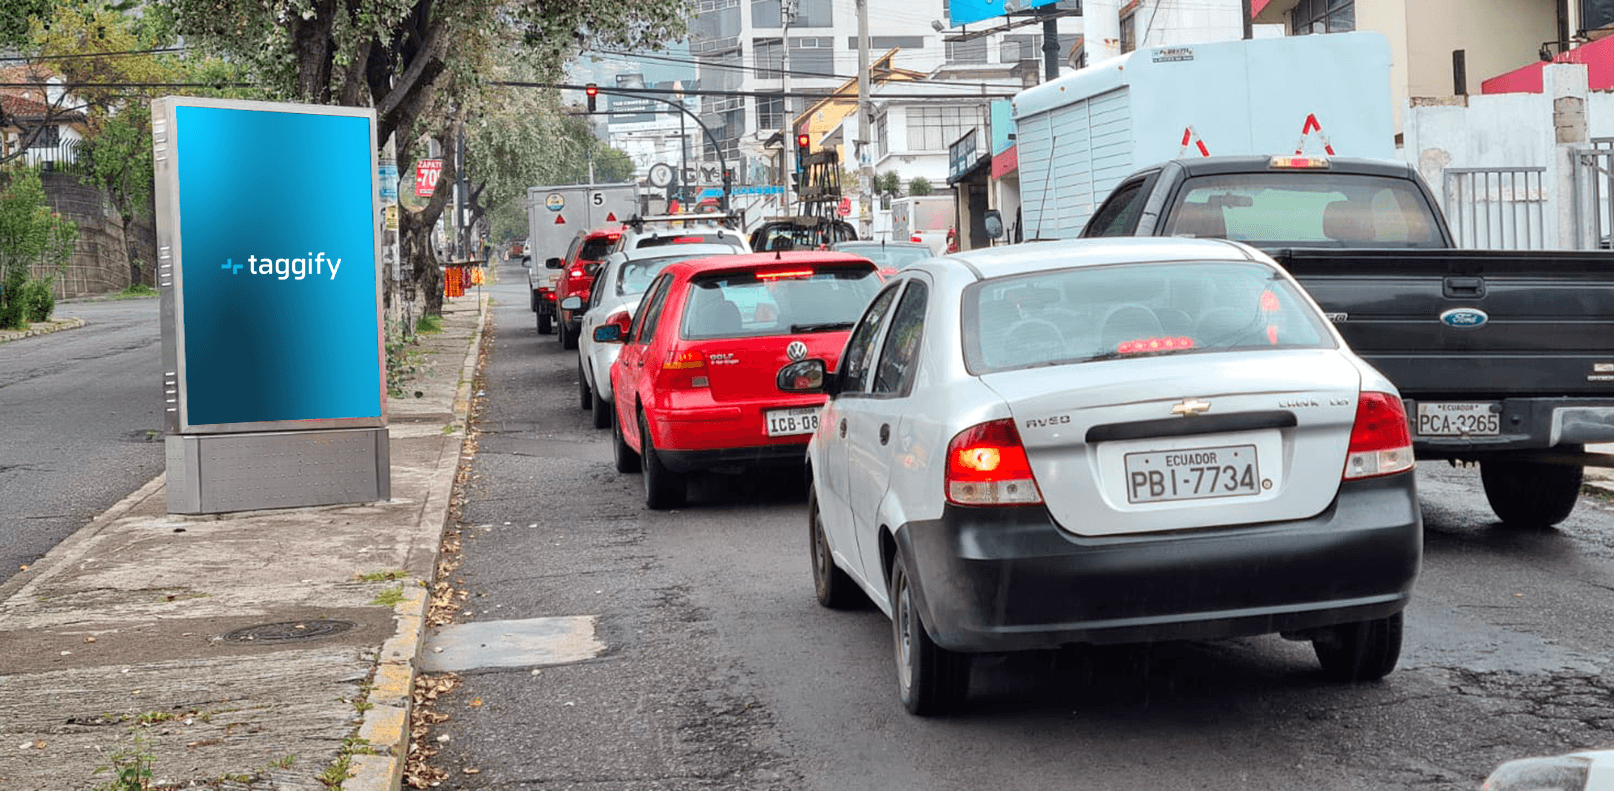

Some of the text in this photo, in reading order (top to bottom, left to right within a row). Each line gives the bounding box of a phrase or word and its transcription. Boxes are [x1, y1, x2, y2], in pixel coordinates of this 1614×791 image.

[594, 193, 603, 205] 5
[248, 252, 341, 280] taggify
[1026, 415, 1070, 428] AVEO
[1420, 415, 1498, 432] PCA-3265
[1165, 452, 1218, 467] ECUADOR
[1131, 463, 1255, 499] PBI-7734
